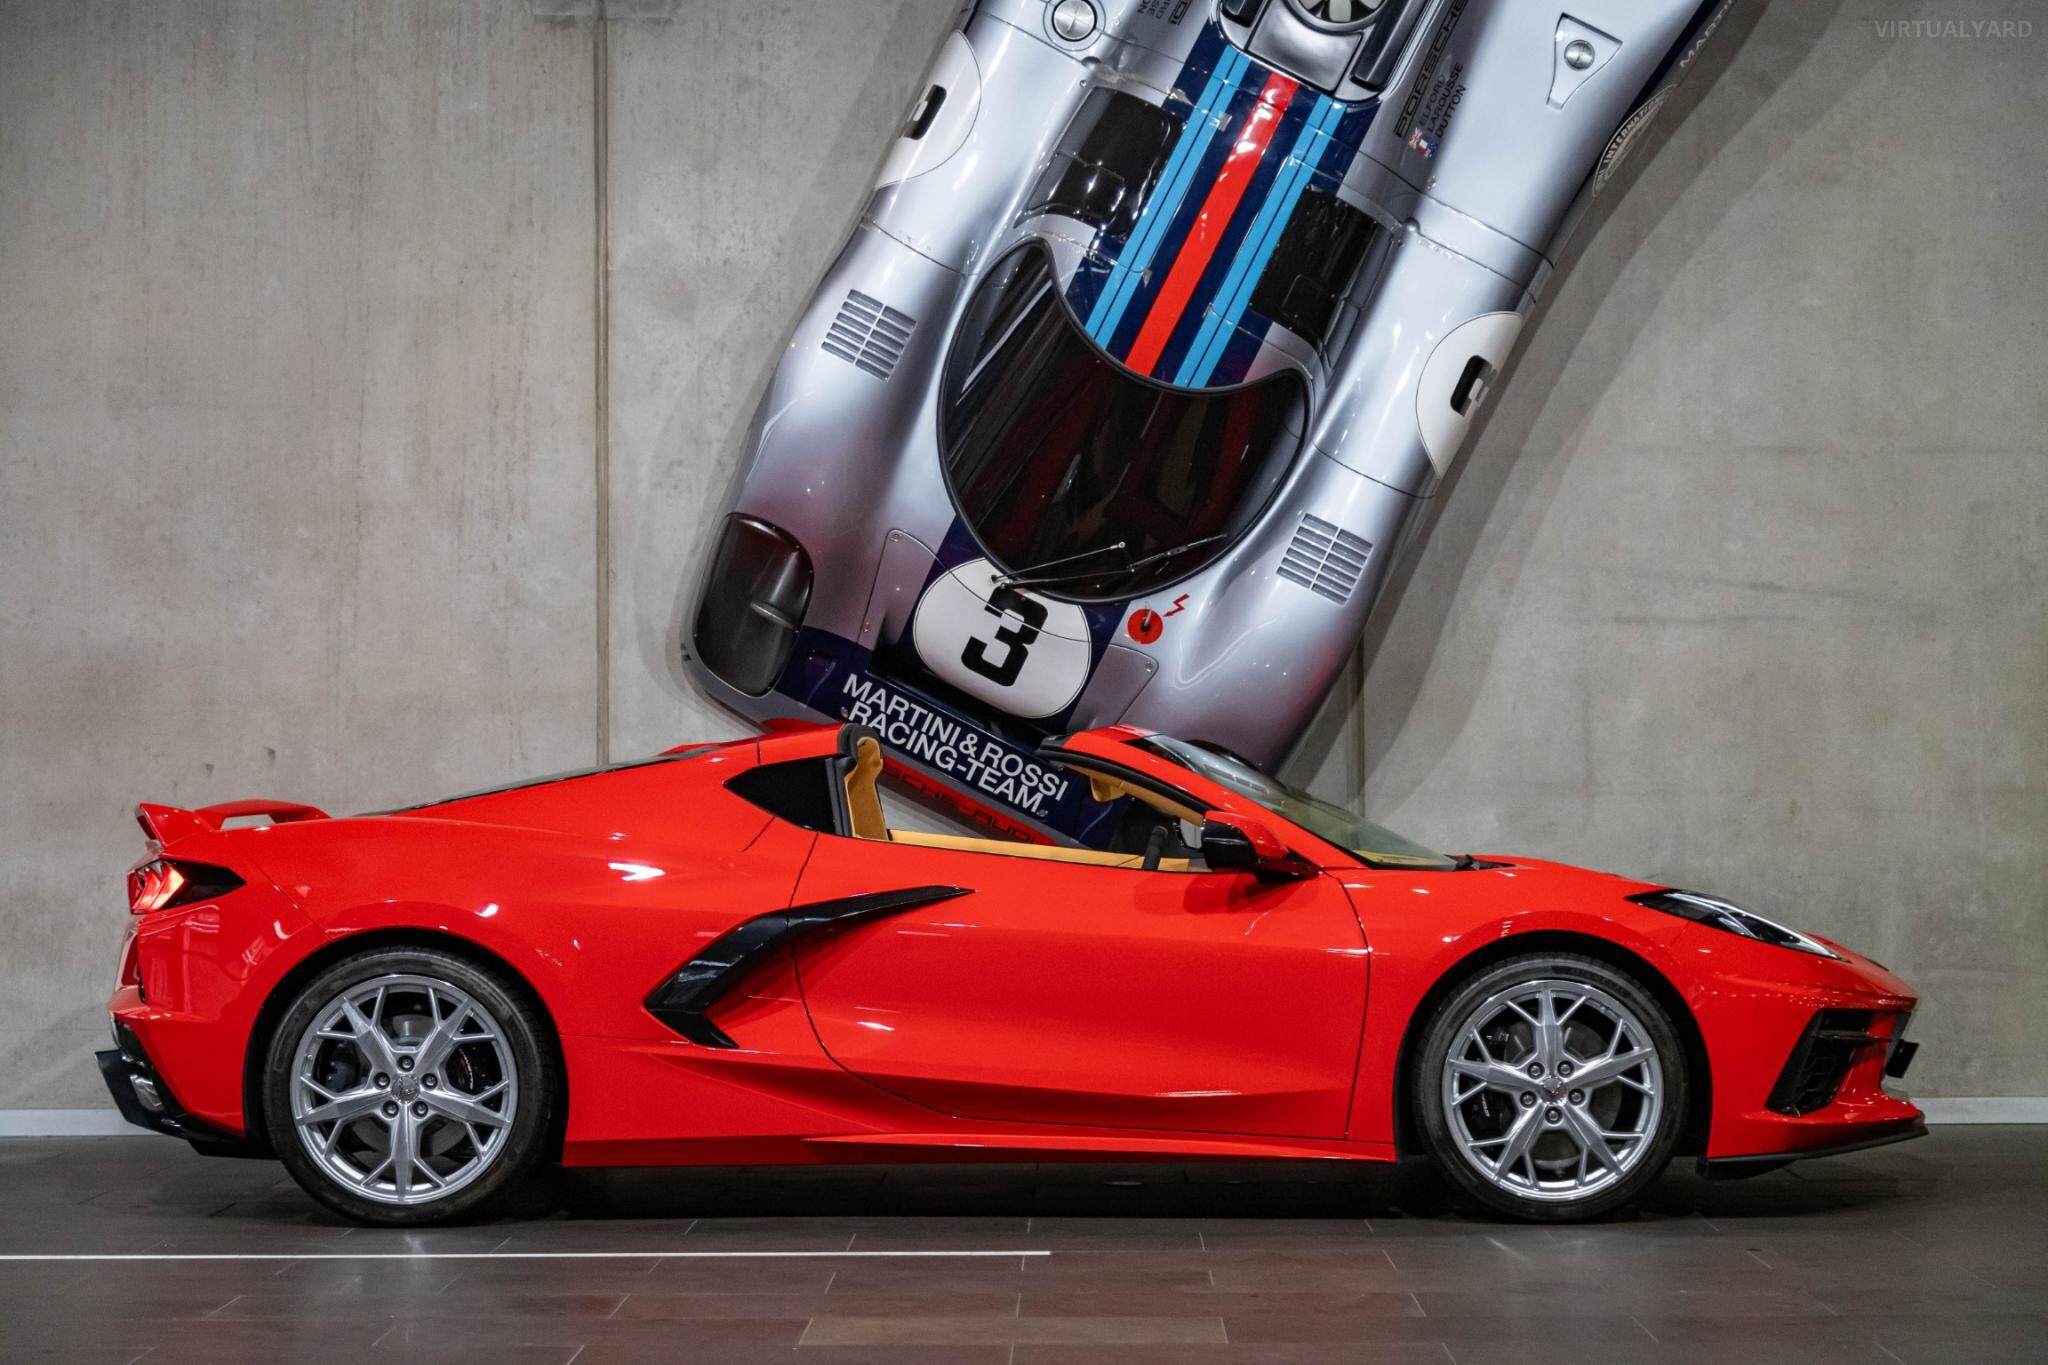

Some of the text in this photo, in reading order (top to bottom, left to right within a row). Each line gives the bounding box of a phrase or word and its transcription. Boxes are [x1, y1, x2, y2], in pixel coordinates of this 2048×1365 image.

[1428, 62, 1464, 133] LAROUSSE
[1435, 84, 1467, 138] DUTTON
[961, 584, 1048, 687] 3
[843, 673, 1069, 801] MARTINI & ROSSI
[849, 701, 1044, 814] RACING-TEAM
